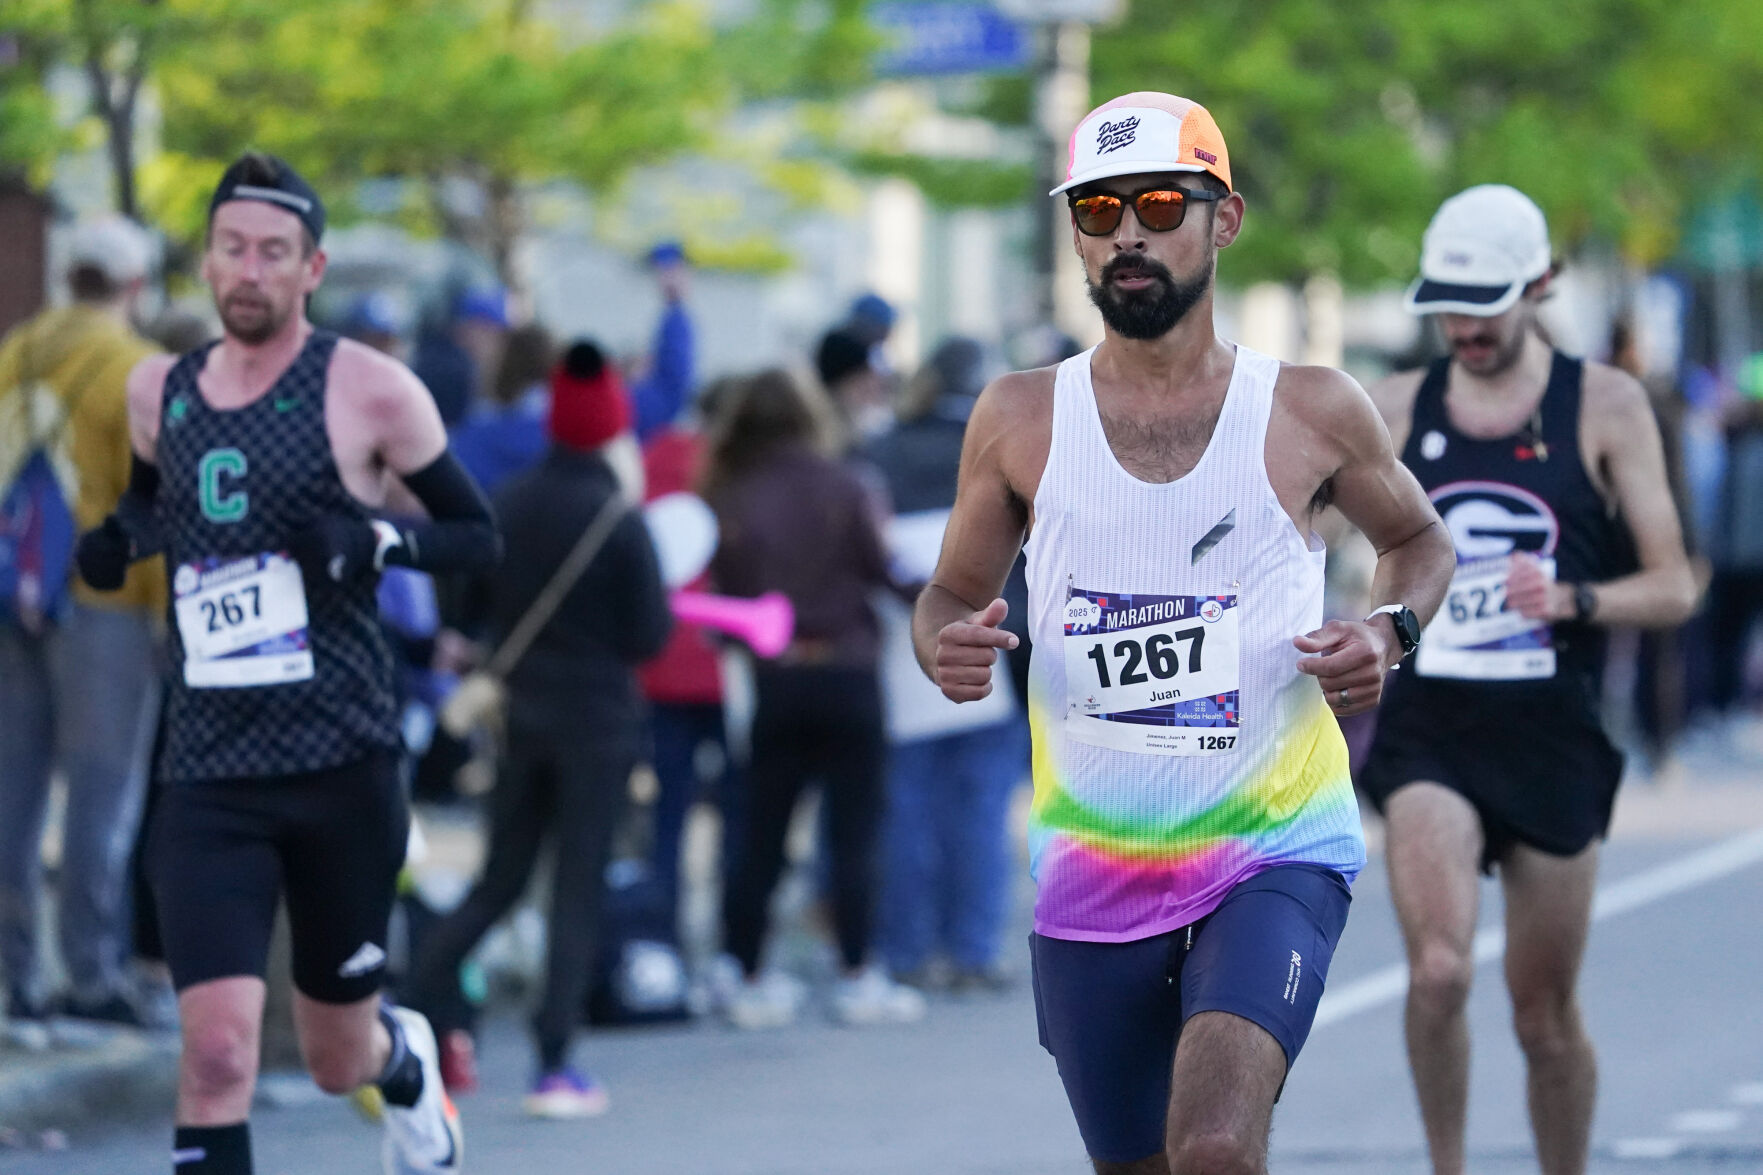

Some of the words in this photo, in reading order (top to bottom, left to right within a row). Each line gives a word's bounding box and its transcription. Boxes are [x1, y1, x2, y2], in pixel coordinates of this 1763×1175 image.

[1097, 116, 1141, 142] Party
[1097, 131, 1136, 155] Pace
[198, 447, 249, 524] C
[201, 586, 260, 632] 267
[1069, 607, 1088, 617] 2025
[1106, 599, 1185, 629] MARATHON
[1087, 626, 1205, 688] 1267
[1150, 689, 1181, 702] Juan
[1177, 712, 1200, 720] Kaleida
[1197, 736, 1236, 750] 1267
